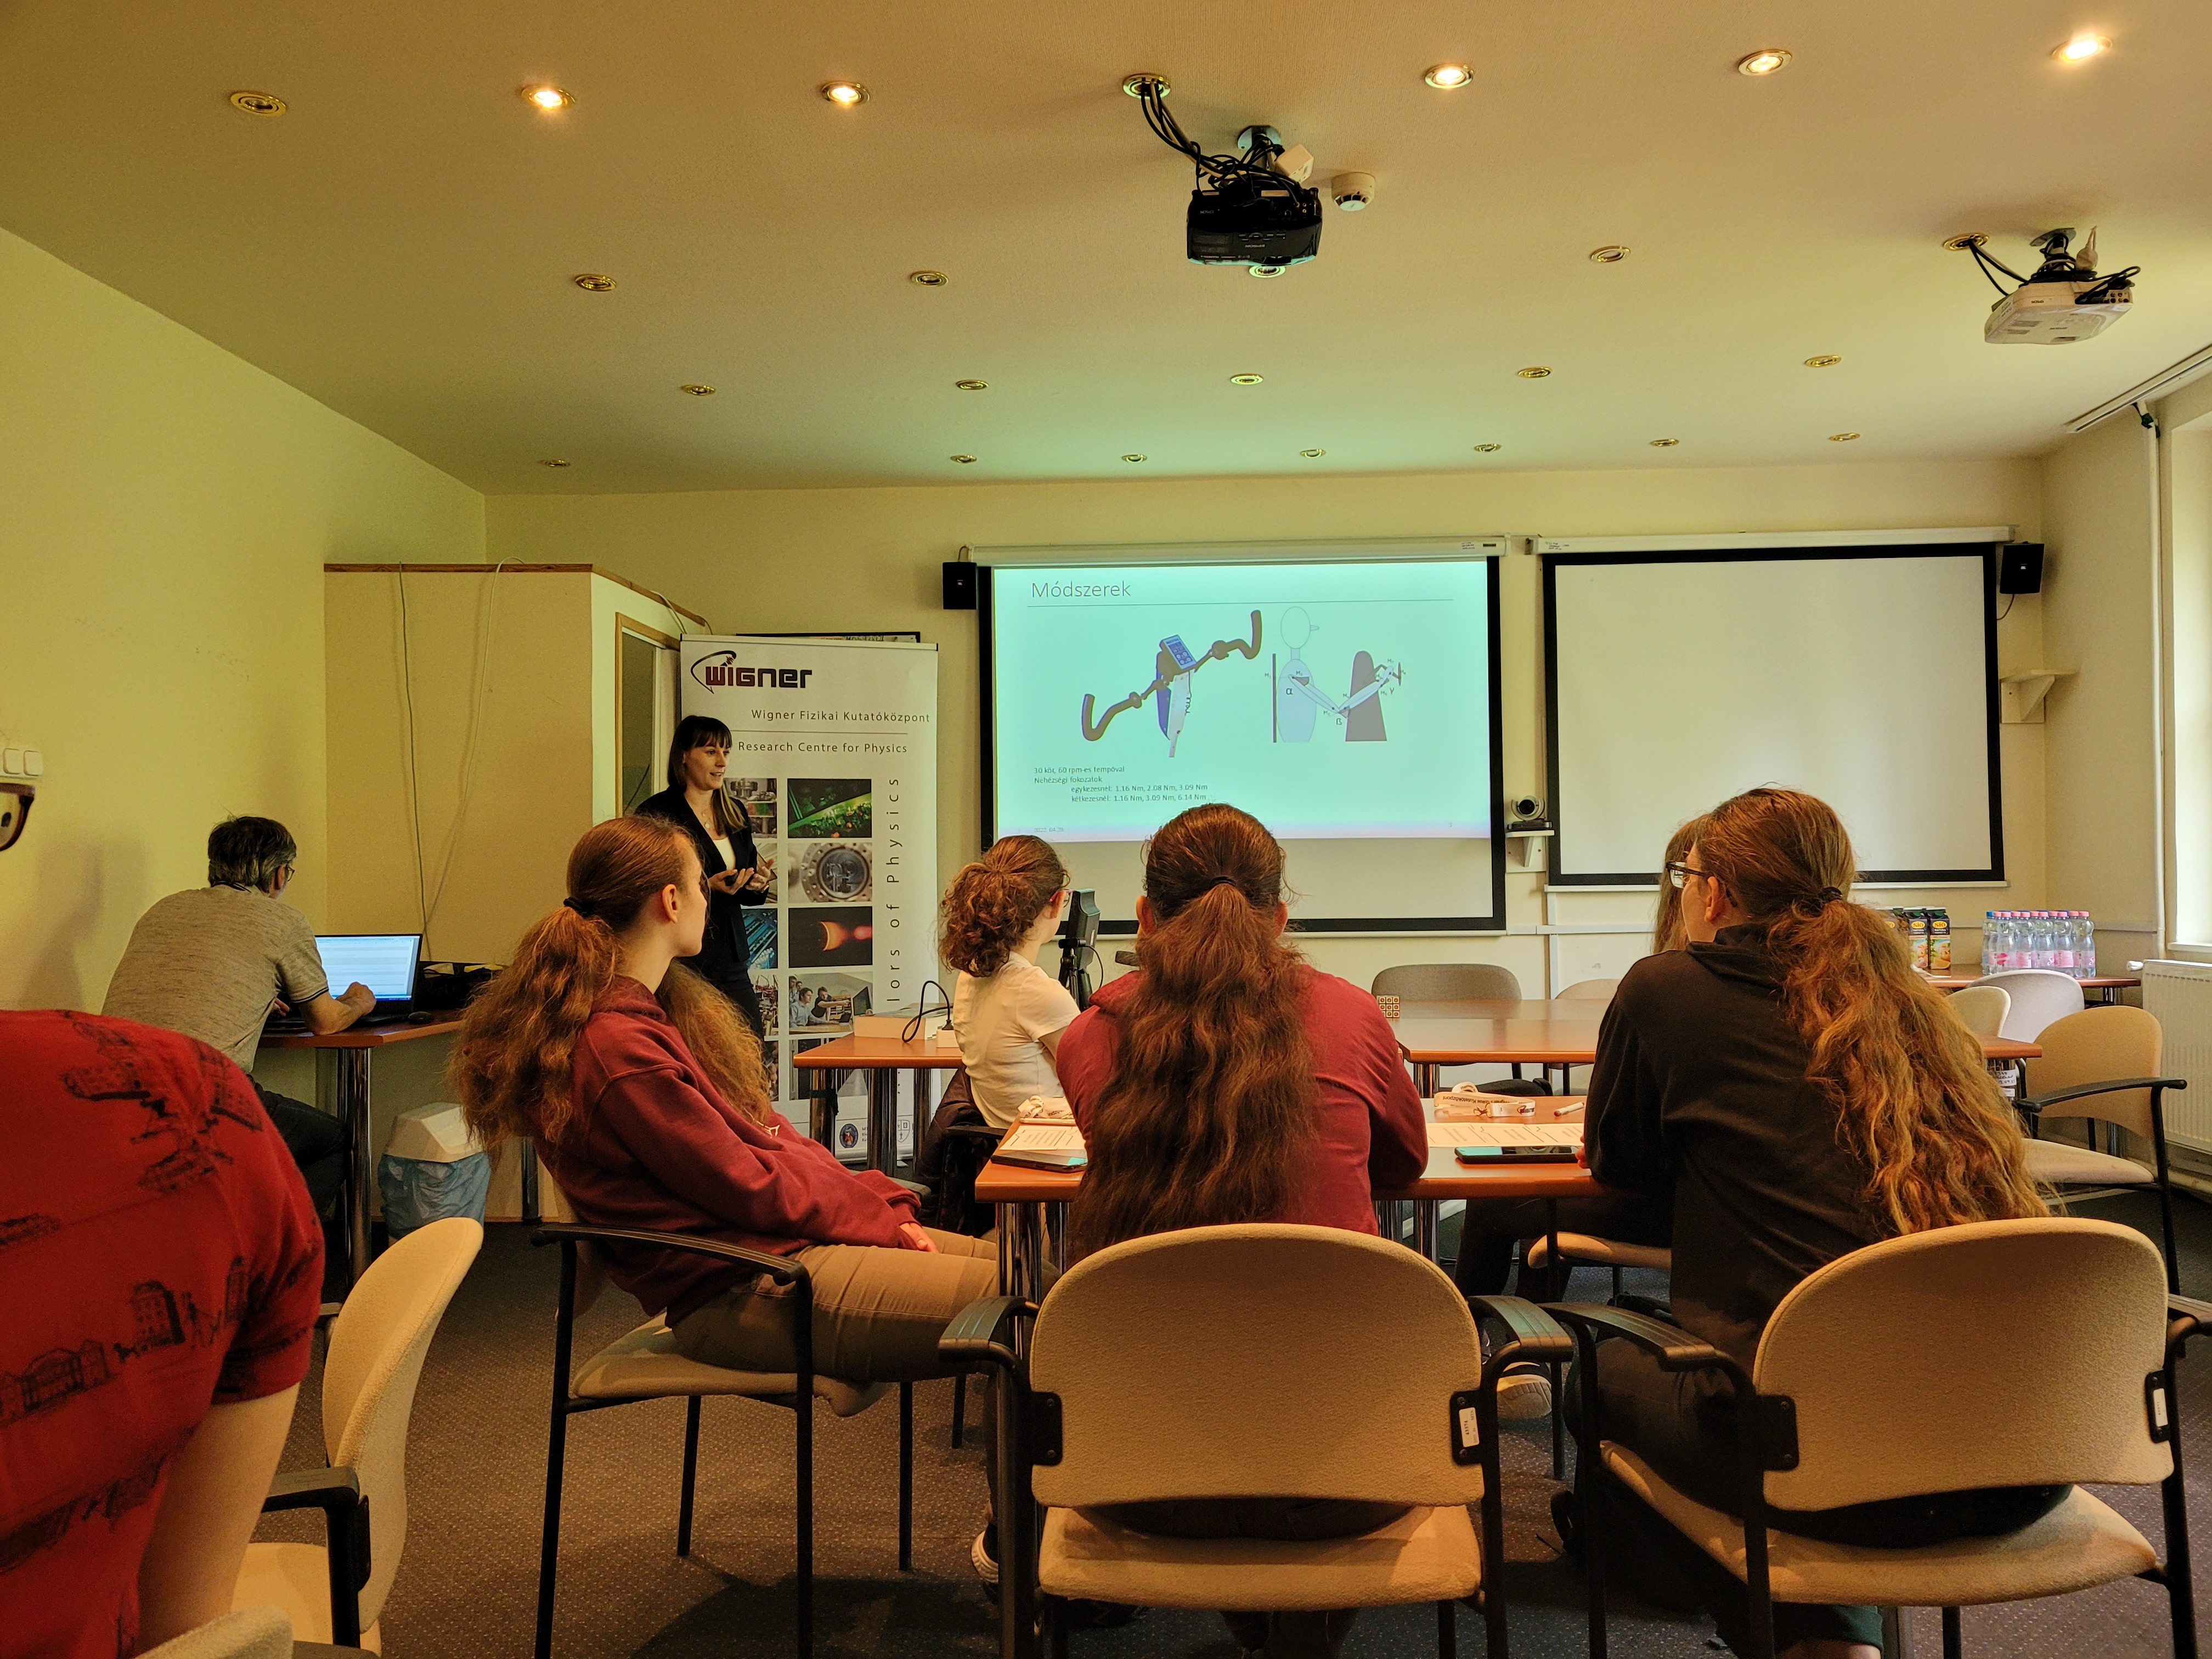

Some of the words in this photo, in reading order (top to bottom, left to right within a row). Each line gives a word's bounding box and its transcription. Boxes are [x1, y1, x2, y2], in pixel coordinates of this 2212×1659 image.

[1032, 580, 1131, 597] Módszerek
[752, 709, 795, 721] Wigner
[800, 710, 838, 720] Fizikai
[843, 711, 930, 724] Kutatóközpont
[738, 742, 793, 752] Research
[798, 742, 838, 752] Centre
[843, 743, 859, 752] for
[864, 743, 907, 754] Physics
[1094, 766, 1125, 774] tempóval
[886, 778, 902, 883] Physics
[887, 904, 900, 928] of
[887, 950, 900, 1001] lors
